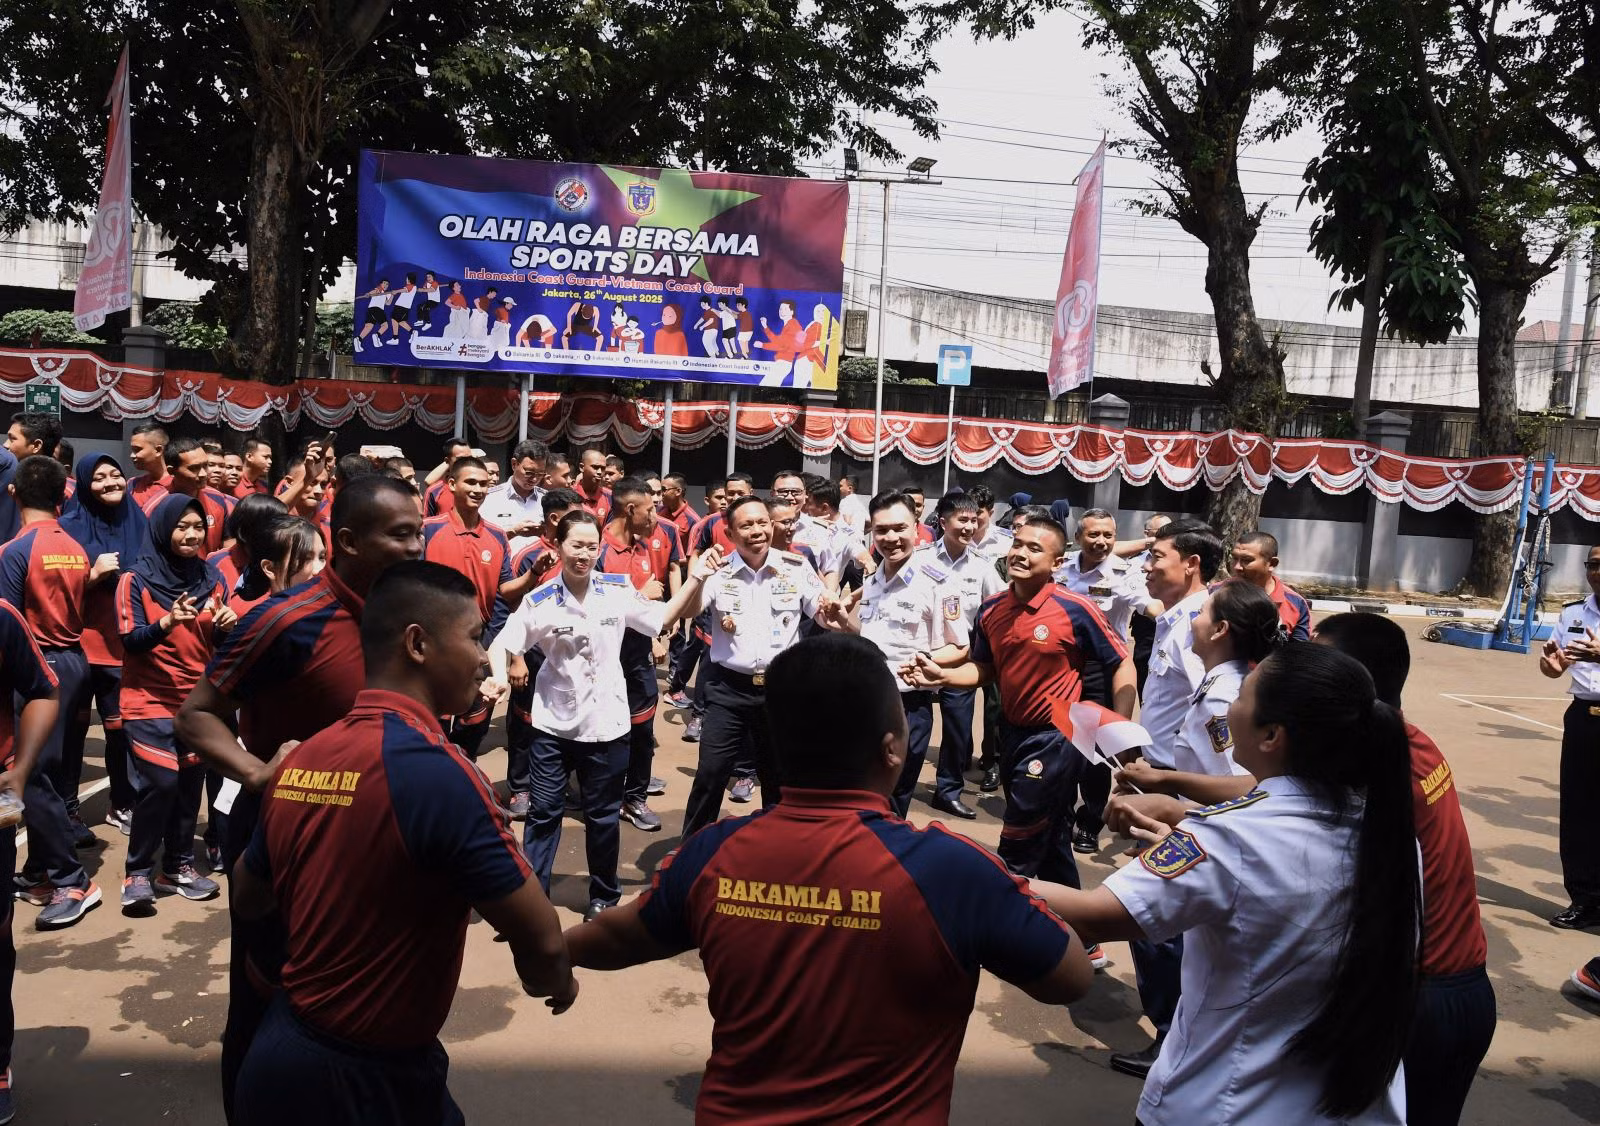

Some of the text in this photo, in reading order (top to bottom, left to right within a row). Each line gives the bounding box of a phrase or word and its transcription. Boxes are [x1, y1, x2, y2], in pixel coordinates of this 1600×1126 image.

[439, 215, 760, 256] OLAH RAGA BERSAMA
[511, 245, 700, 277] SPORTS DAY
[464, 267, 744, 295] Indonesia Coast Guard-Vietnam Coast Guard
[542, 289, 582, 300] Jakarta,
[603, 293, 637, 303] August
[640, 293, 663, 303] 2025
[943, 350, 967, 380] P
[278, 768, 361, 791] AKAMLA RI
[330, 794, 353, 807] UARD
[717, 877, 882, 914] BAKAMLA RI
[716, 902, 881, 930] INDONESIA COAST GUARD
